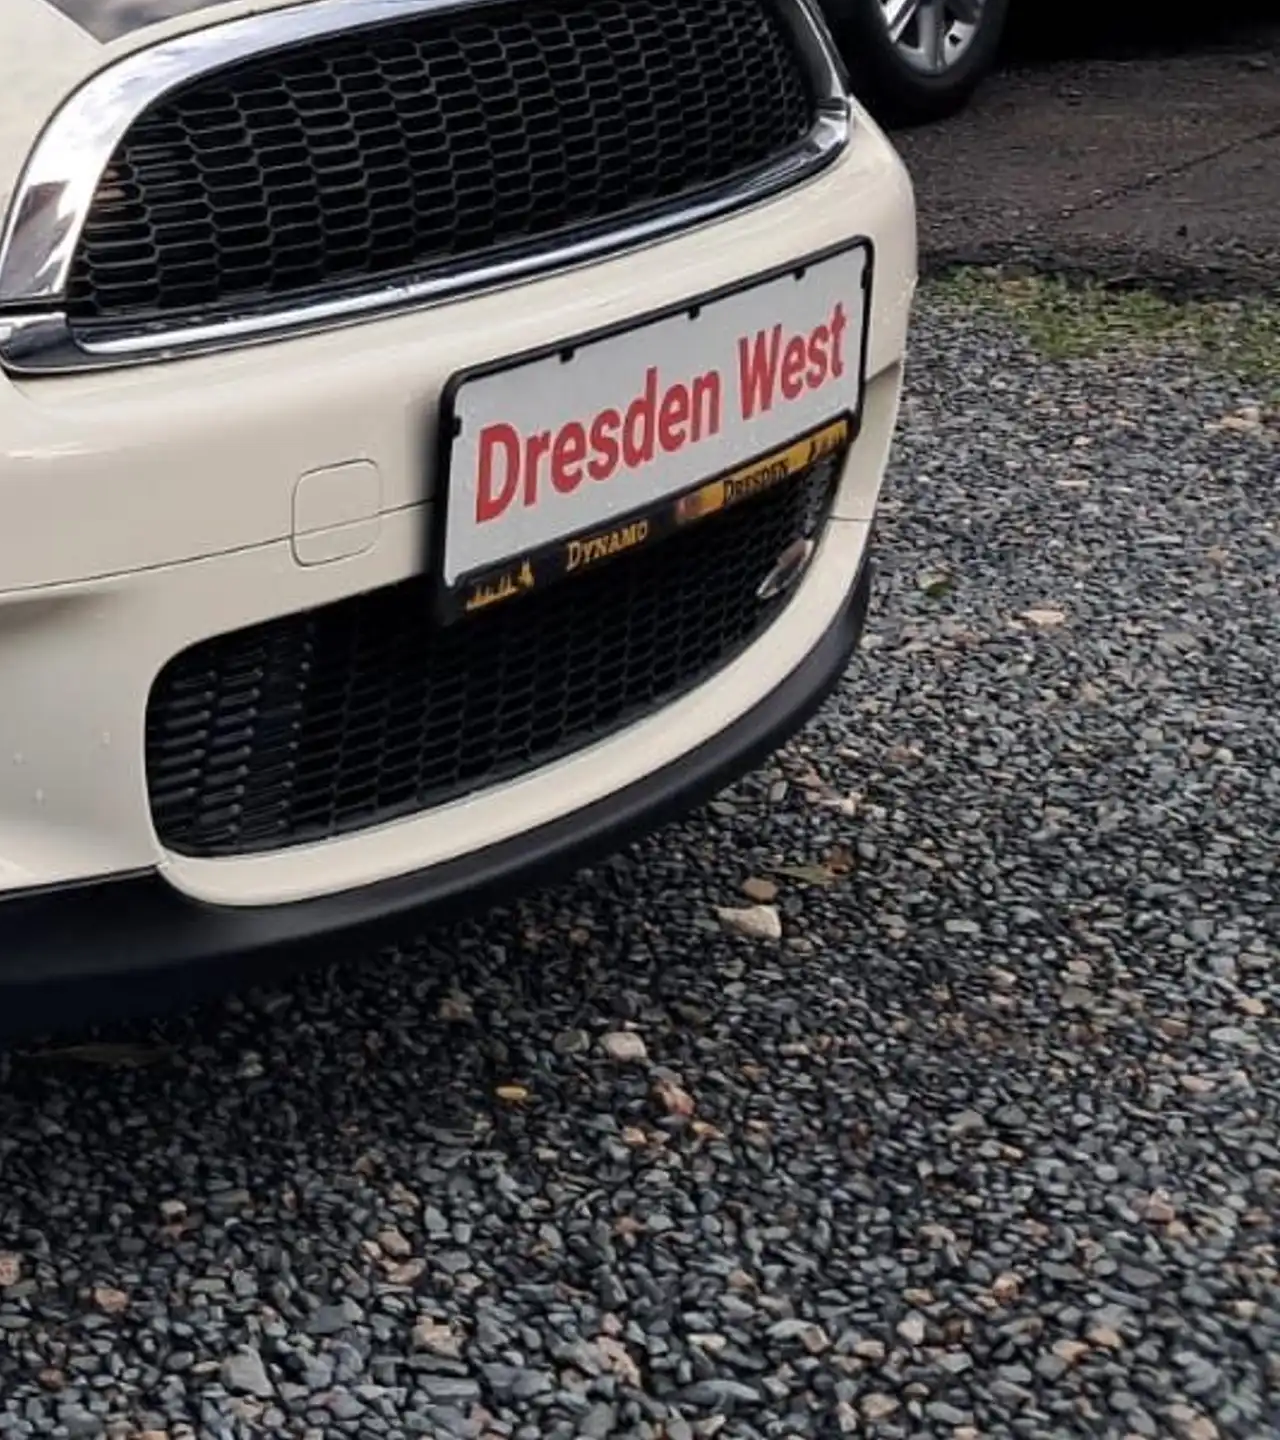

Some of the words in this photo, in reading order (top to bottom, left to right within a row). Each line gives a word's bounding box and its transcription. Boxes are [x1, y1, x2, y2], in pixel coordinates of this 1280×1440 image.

[476, 366, 721, 525] Dresden
[738, 302, 846, 421] West
[566, 519, 648, 572] DYNAMO
